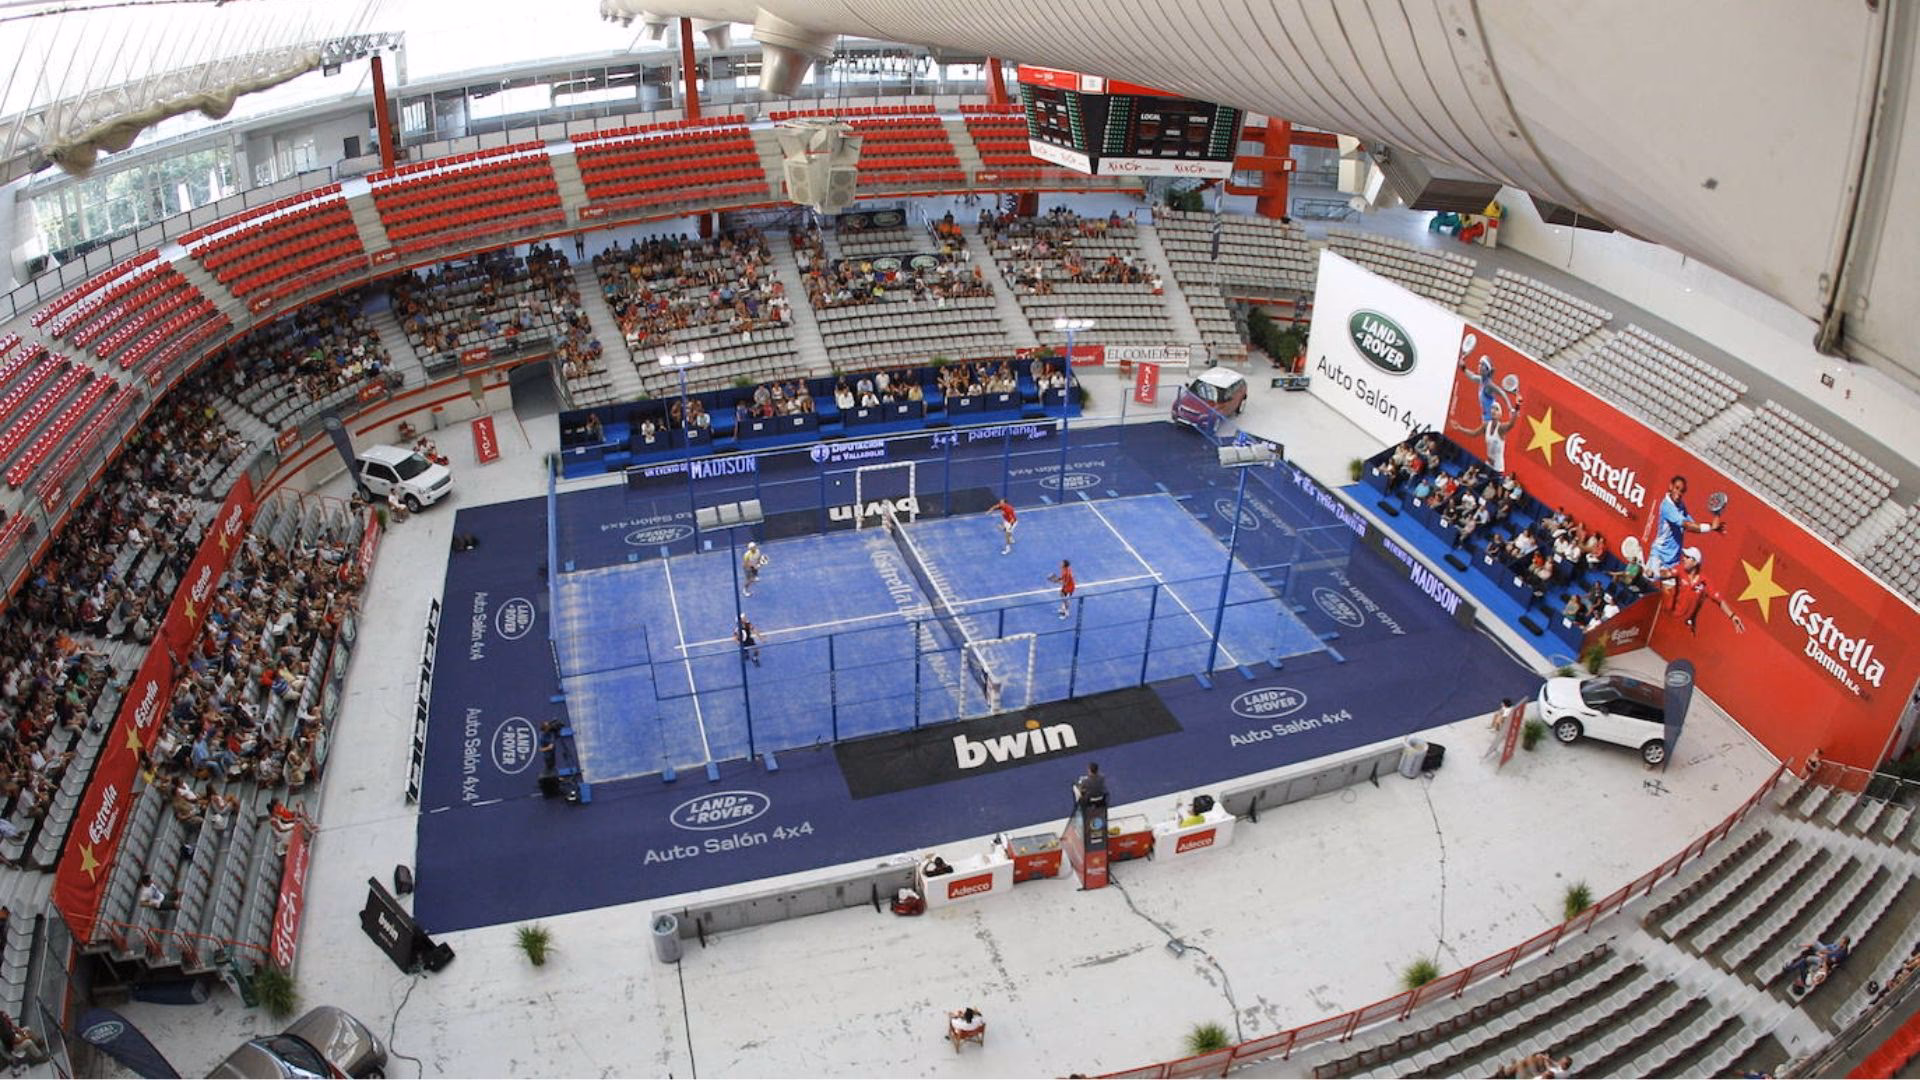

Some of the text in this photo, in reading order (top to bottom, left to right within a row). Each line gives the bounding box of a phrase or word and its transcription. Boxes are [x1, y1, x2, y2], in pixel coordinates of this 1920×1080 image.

[1361, 316, 1397, 346] LAND
[1362, 335, 1405, 369] ROVER
[1316, 355, 1352, 391] Auto
[1356, 378, 1399, 422] Salón
[691, 455, 756, 480] MADISON
[1565, 432, 1646, 508] Estrella
[1581, 471, 1617, 509] Damm
[1410, 561, 1459, 616] MADISON
[1789, 589, 1886, 688] Estrella
[1804, 636, 1848, 683] Damm
[1244, 691, 1278, 706] LAND
[1254, 696, 1297, 713] ROVER
[516, 727, 530, 754] LAND
[953, 719, 1078, 769] bwin
[1229, 709, 1353, 747] Auto Salón 4x4
[462, 708, 482, 801] Auto Salón 4x4
[502, 732, 516, 765] ROVER
[88, 783, 119, 845] Estrella
[690, 796, 737, 814] LAND
[697, 804, 754, 824] ROVER
[643, 821, 815, 865] Auto Salón 4x4
[1179, 837, 1213, 851] Adecco
[951, 882, 990, 897] Adecco
